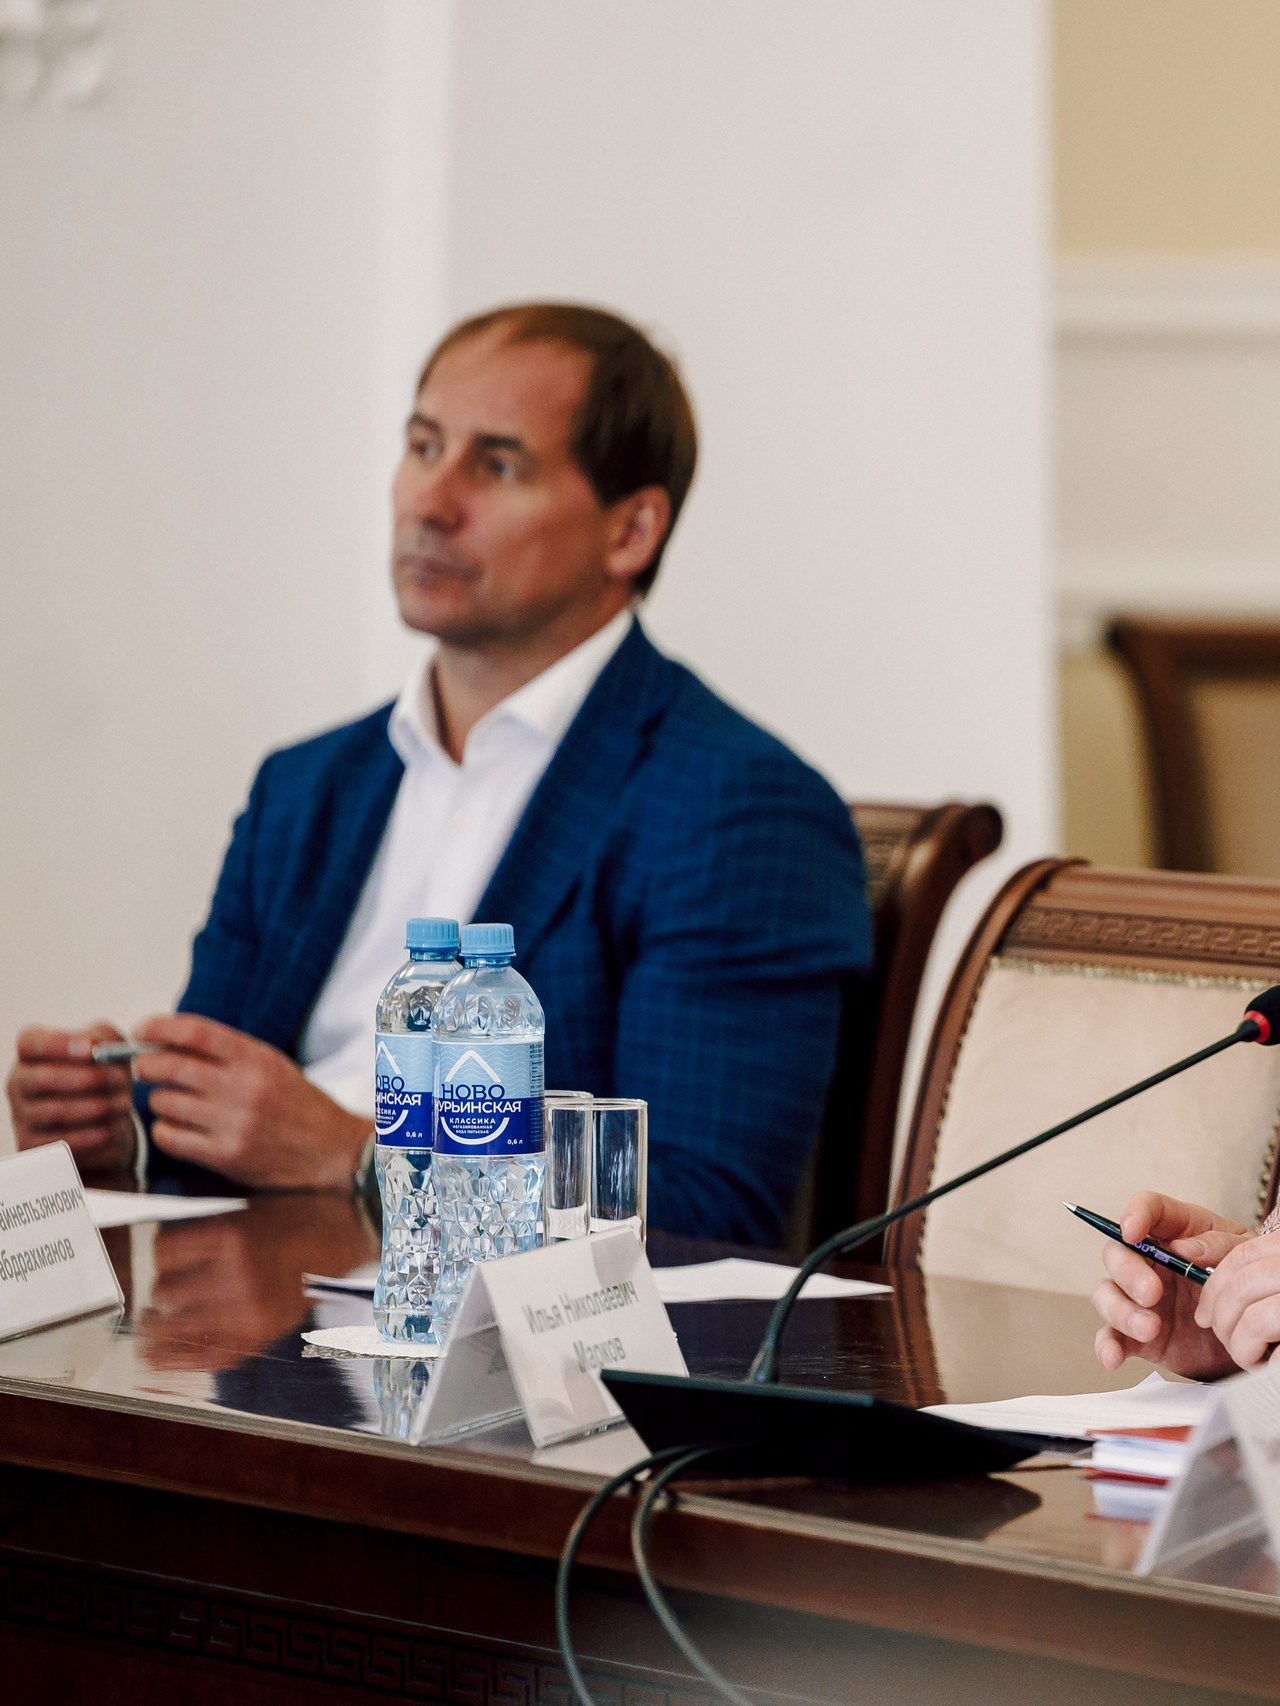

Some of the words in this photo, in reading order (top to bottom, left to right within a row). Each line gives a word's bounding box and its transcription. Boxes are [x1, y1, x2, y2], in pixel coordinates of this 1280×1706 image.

[441, 1084, 506, 1100] НОВО
[449, 1117, 496, 1125] КЛАССИКА
[521, 1304, 564, 1335] Илья
[558, 1280, 639, 1324] Николаевич
[573, 1337, 626, 1373] Марков
